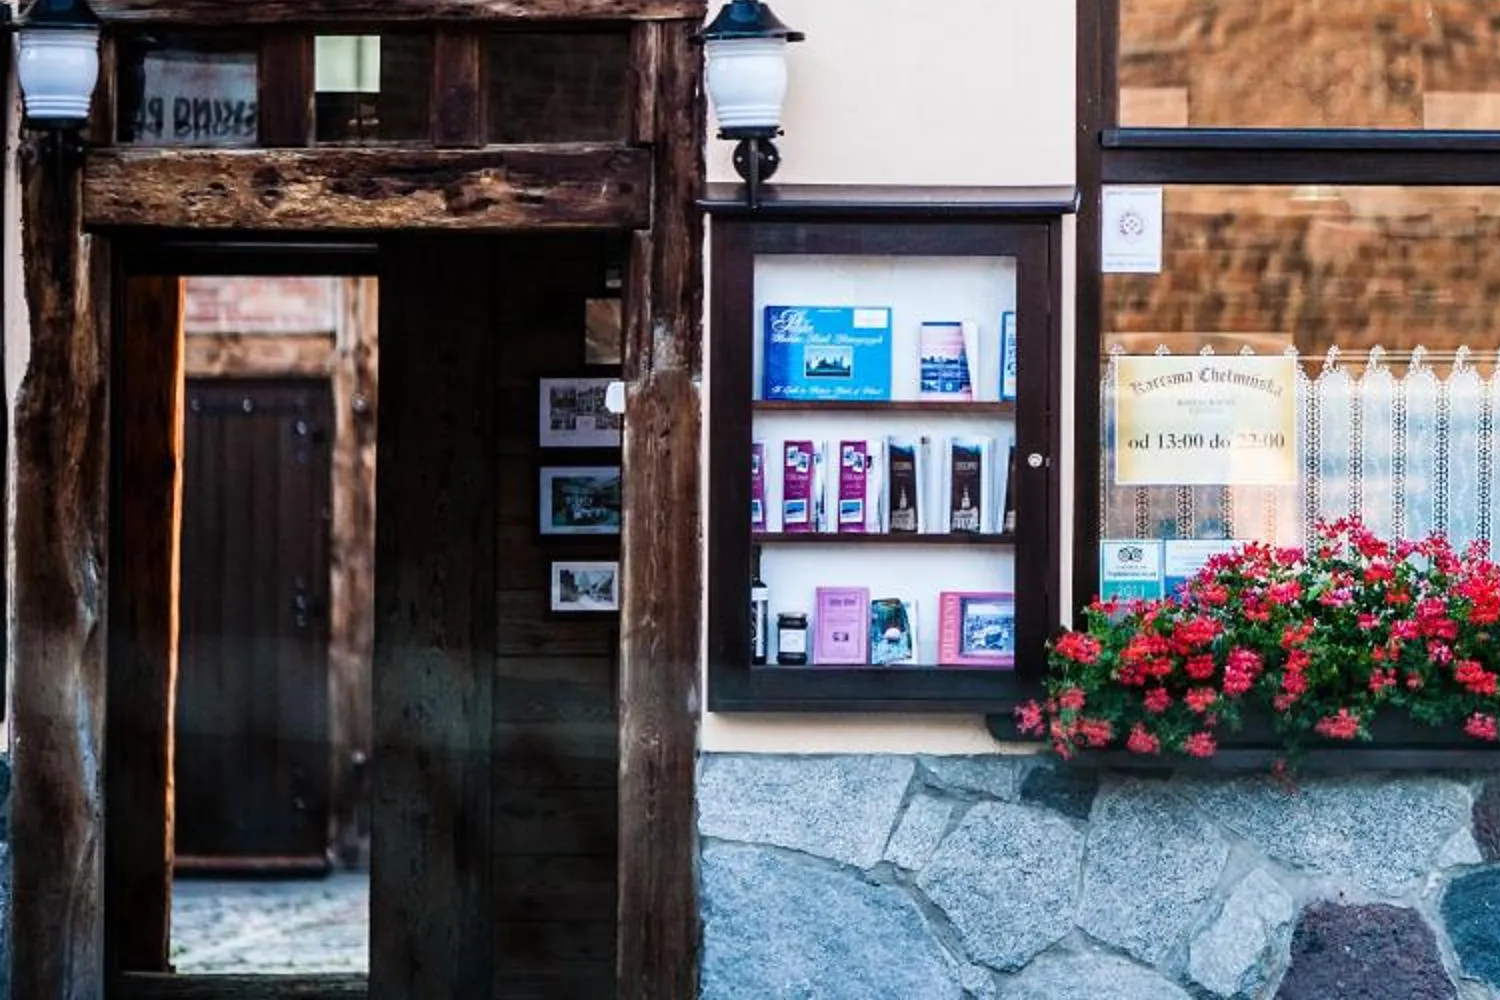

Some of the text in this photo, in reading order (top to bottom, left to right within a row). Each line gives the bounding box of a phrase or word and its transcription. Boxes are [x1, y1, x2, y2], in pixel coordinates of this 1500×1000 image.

[1127, 433, 1149, 449] od
[1156, 433, 1204, 450] 13:00
[1209, 433, 1231, 449] do
